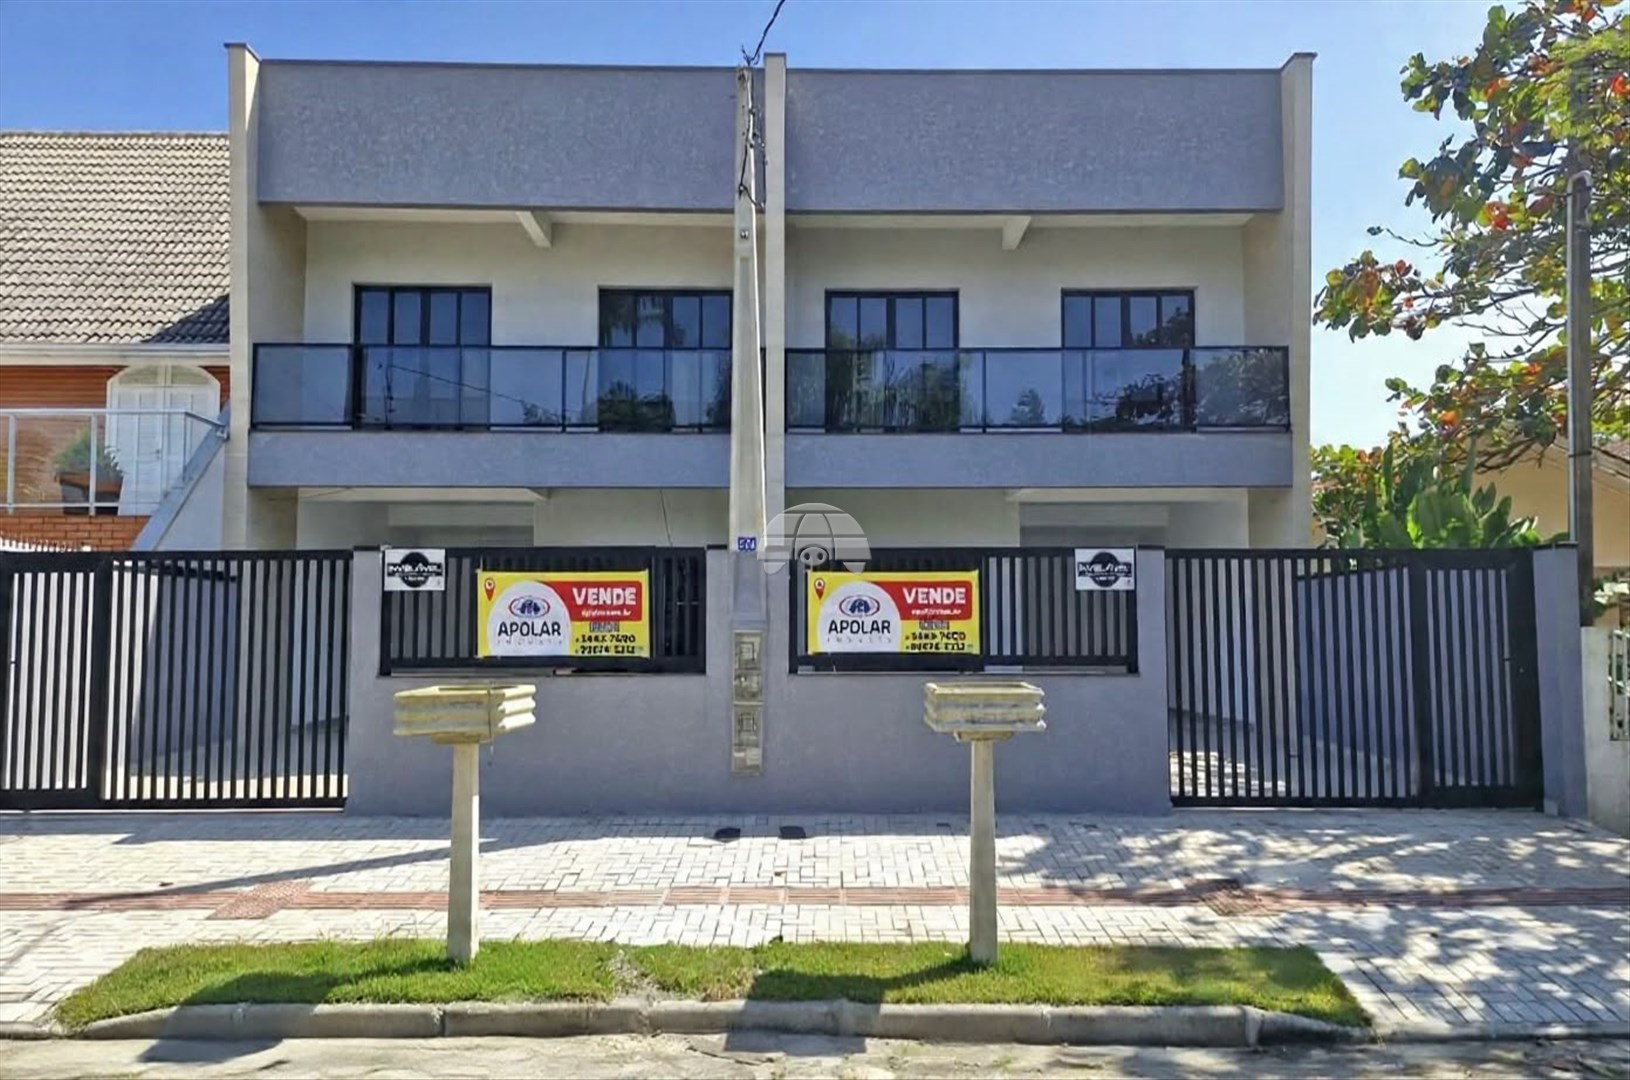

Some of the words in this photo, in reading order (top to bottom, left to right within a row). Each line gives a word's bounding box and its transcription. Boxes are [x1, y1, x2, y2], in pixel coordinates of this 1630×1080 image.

[572, 587, 636, 606] VENDE
[902, 587, 966, 605] VENDE
[497, 621, 562, 637] APOLAR
[828, 620, 891, 635] APOLAR
